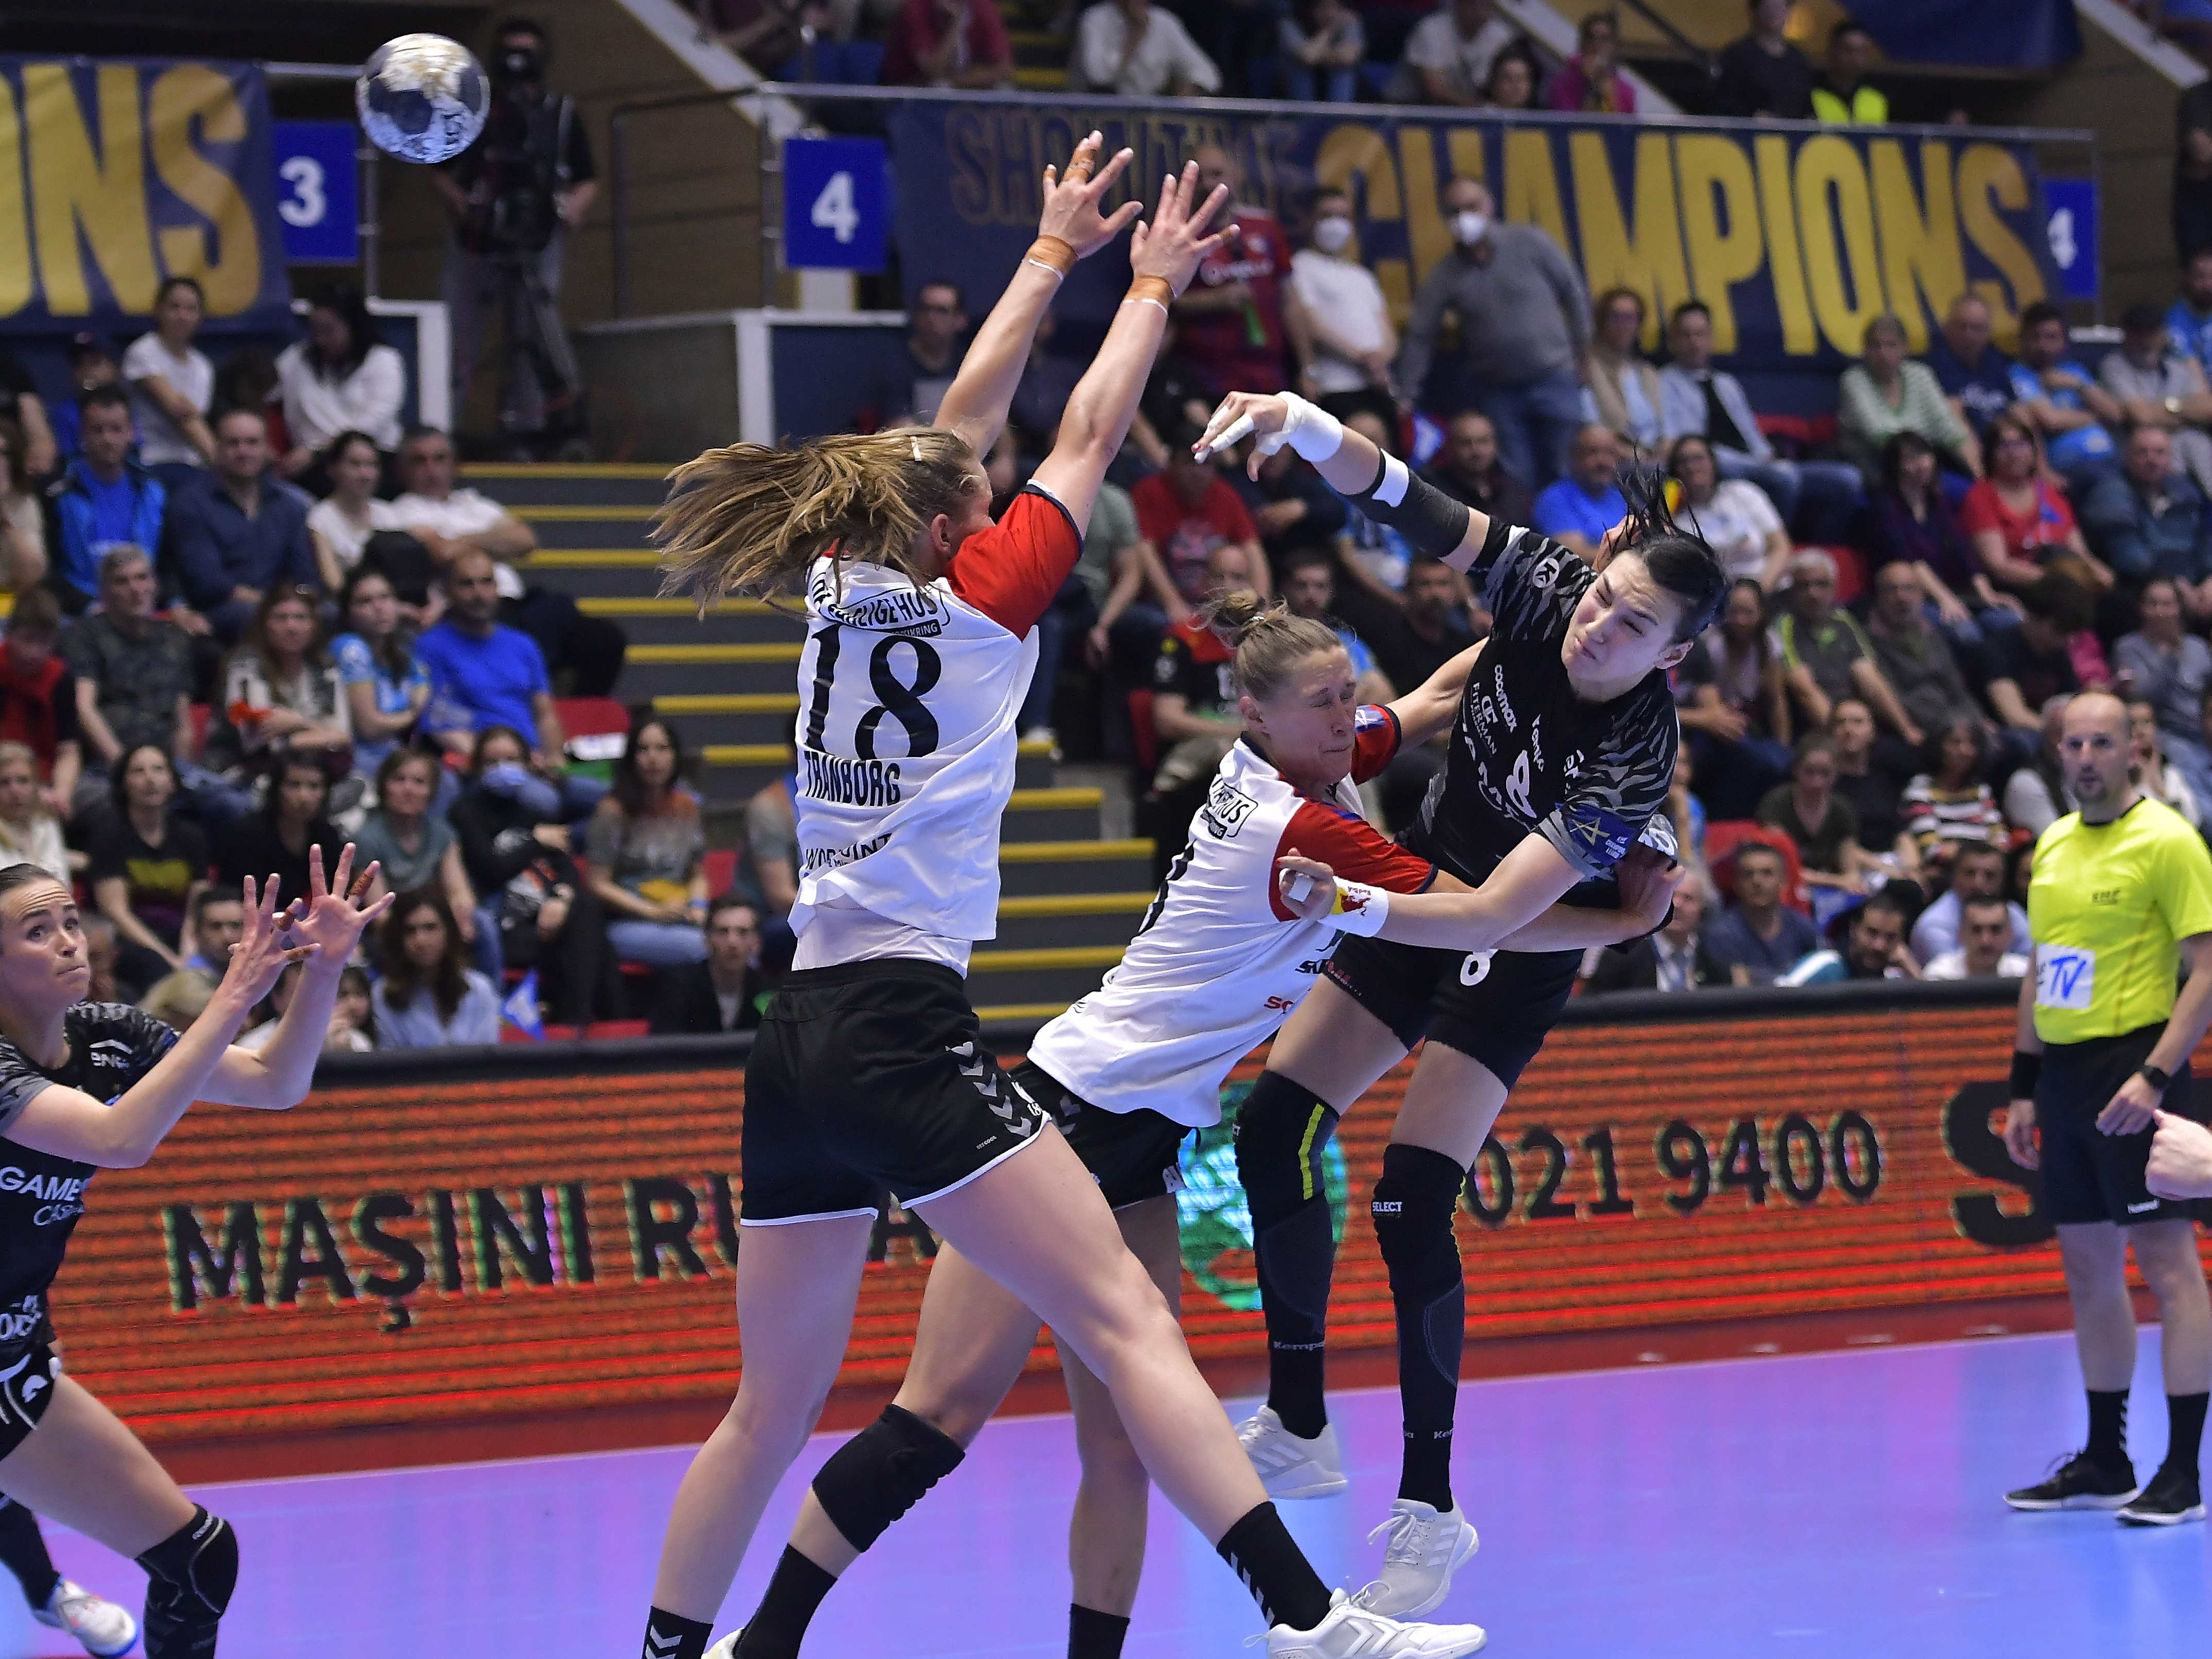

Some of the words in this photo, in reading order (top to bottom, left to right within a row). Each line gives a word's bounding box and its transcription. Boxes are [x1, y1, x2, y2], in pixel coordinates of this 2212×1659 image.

[279, 155, 328, 228] 3
[811, 171, 861, 244] 4
[803, 623, 941, 760] 18
[1472, 682, 1497, 755] FITERMAN
[804, 751, 900, 807] TRANBORG
[1506, 749, 1537, 818] 8
[2050, 956, 2087, 1000] TV
[1465, 1128, 1633, 1223] 021
[1658, 1111, 1880, 1212] 9400
[1372, 1201, 1403, 1212] SELECT
